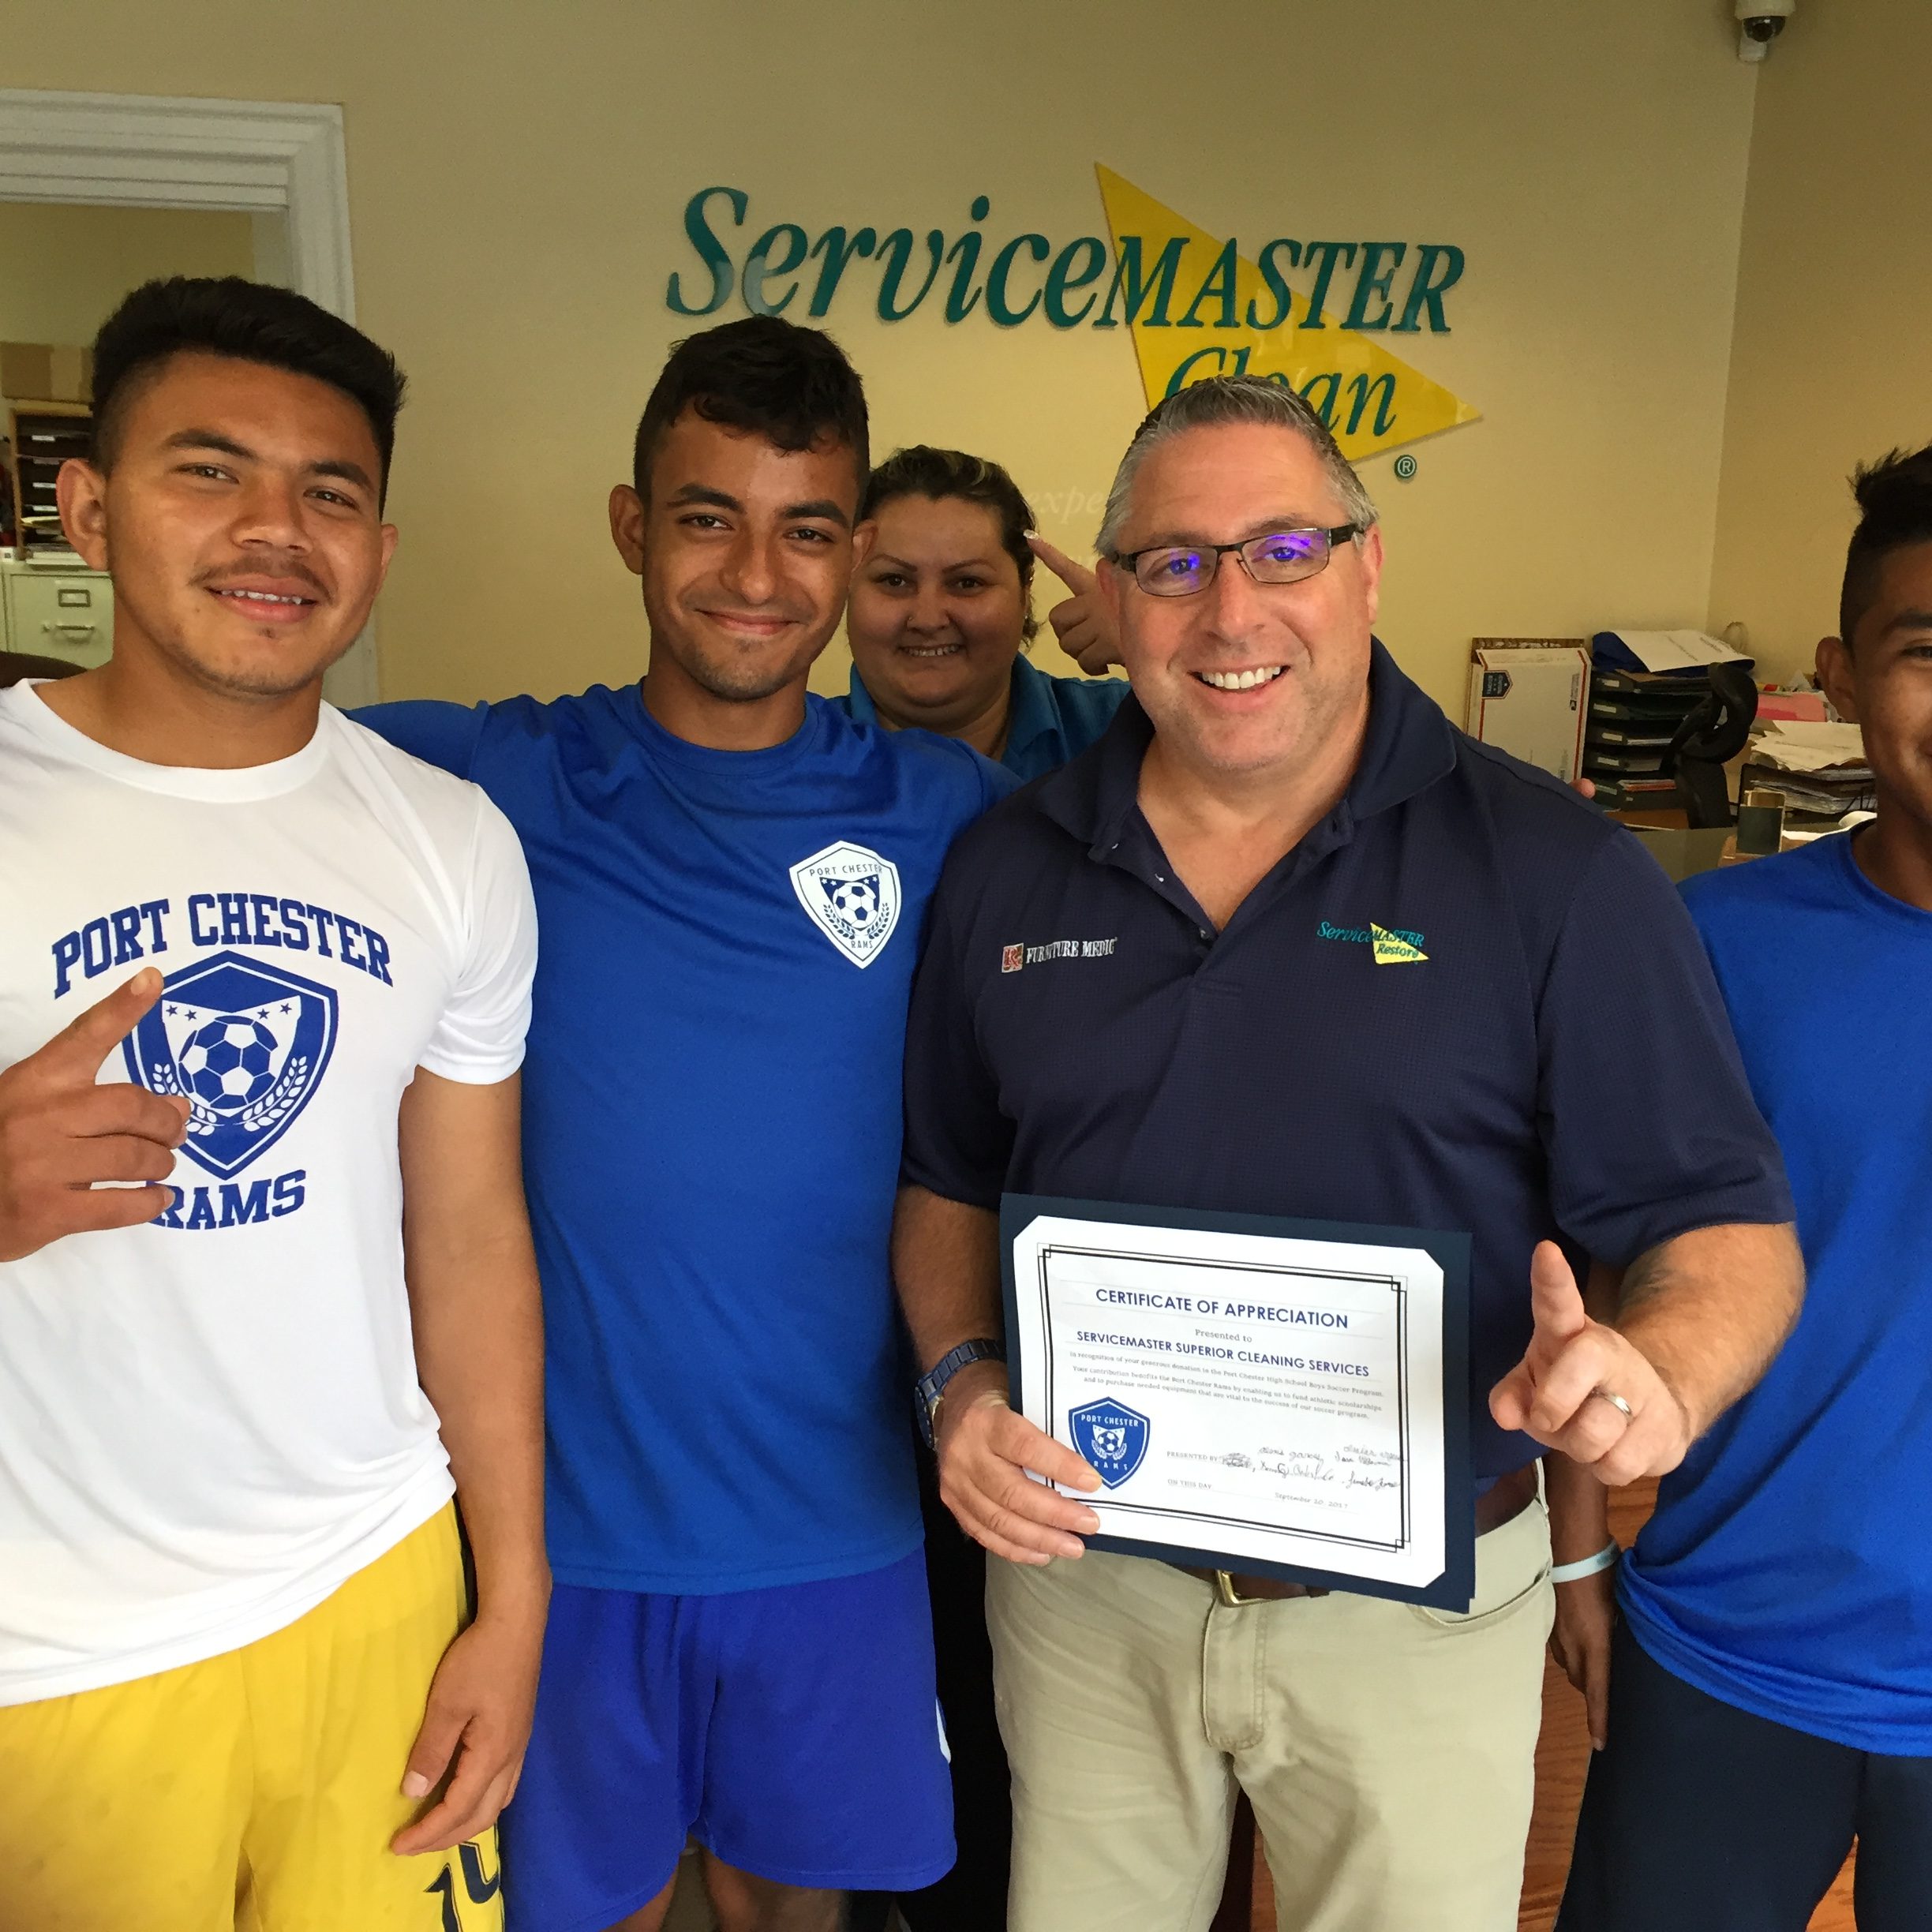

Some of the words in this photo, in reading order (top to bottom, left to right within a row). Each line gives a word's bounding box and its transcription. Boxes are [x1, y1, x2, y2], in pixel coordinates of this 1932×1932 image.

[664, 186, 1469, 335] ServiceMASTER
[1166, 345, 1397, 436] Can
[809, 867, 837, 876] PORT
[842, 863, 882, 874] CHESTER
[51, 898, 170, 1000] PORT
[187, 893, 394, 987] CHESTER
[851, 940, 873, 949] RAMS
[1026, 940, 1080, 964] FURNITURE
[1081, 938, 1115, 957] MEDIC
[1376, 943, 1419, 959] Restore
[1096, 1289, 1192, 1311] CERTIFICATE
[1196, 1300, 1219, 1314] OF
[1225, 1304, 1348, 1328] APPRECIATION
[1195, 1328, 1240, 1341] Presented
[1077, 1331, 1172, 1351] SERVICEMASTER
[1176, 1342, 1234, 1359] SUPERIOR
[1237, 1351, 1305, 1368] CLEANING
[1309, 1360, 1369, 1377] SERVICES
[1077, 1353, 1114, 1361] recognition
[1238, 1372, 1264, 1381] Chester
[1080, 1413, 1102, 1423] PORT
[1104, 1416, 1139, 1427] CHESTER
[1093, 1460, 1128, 1471] RAMS
[1275, 1492, 1311, 1503] September
